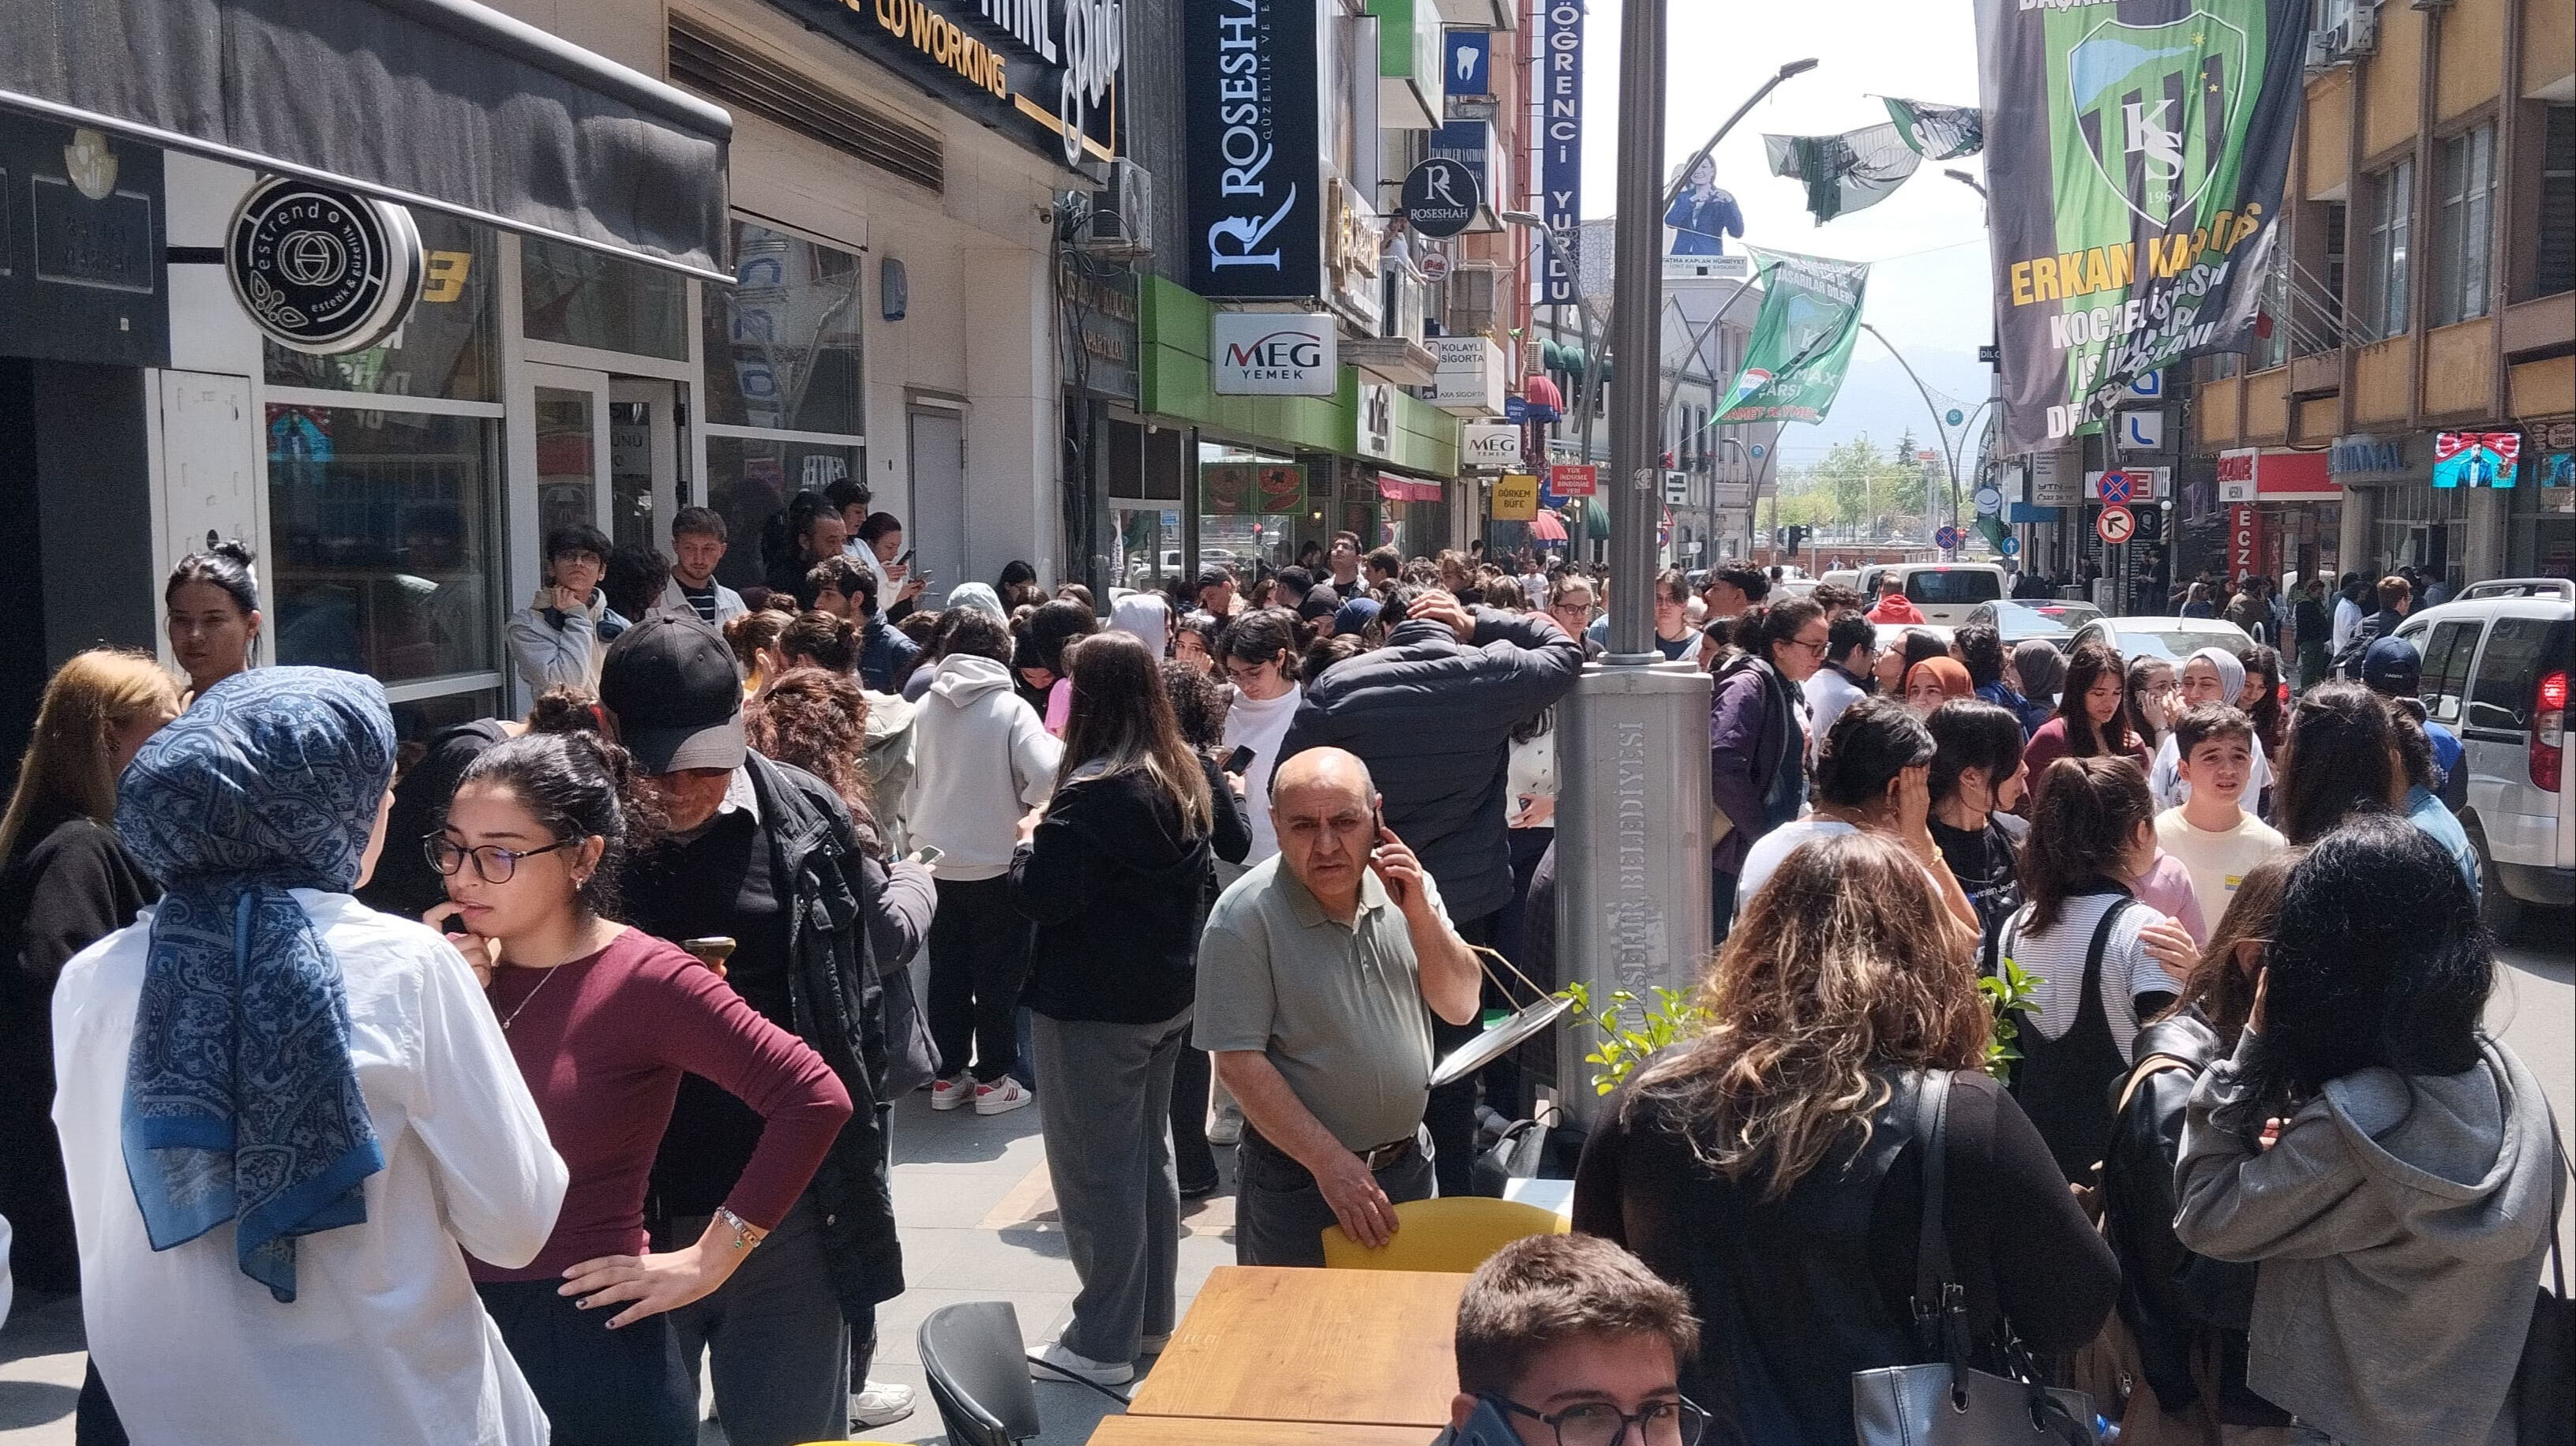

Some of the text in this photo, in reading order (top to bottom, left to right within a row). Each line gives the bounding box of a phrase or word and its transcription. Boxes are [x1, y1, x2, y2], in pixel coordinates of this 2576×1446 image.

[1261, 23, 1270, 43] VE
[1550, 2, 1579, 163] ÖĞRENCİ
[1410, 208, 1469, 223] ROSESHAH
[2010, 241, 2135, 307] ERKAN
[1224, 338, 1321, 368] MEG
[1441, 342, 1483, 352] KOLAYLI
[1441, 353, 1484, 363] SİGORTA
[1242, 369, 1303, 380] YEMEK
[1468, 436, 1515, 451] MEG
